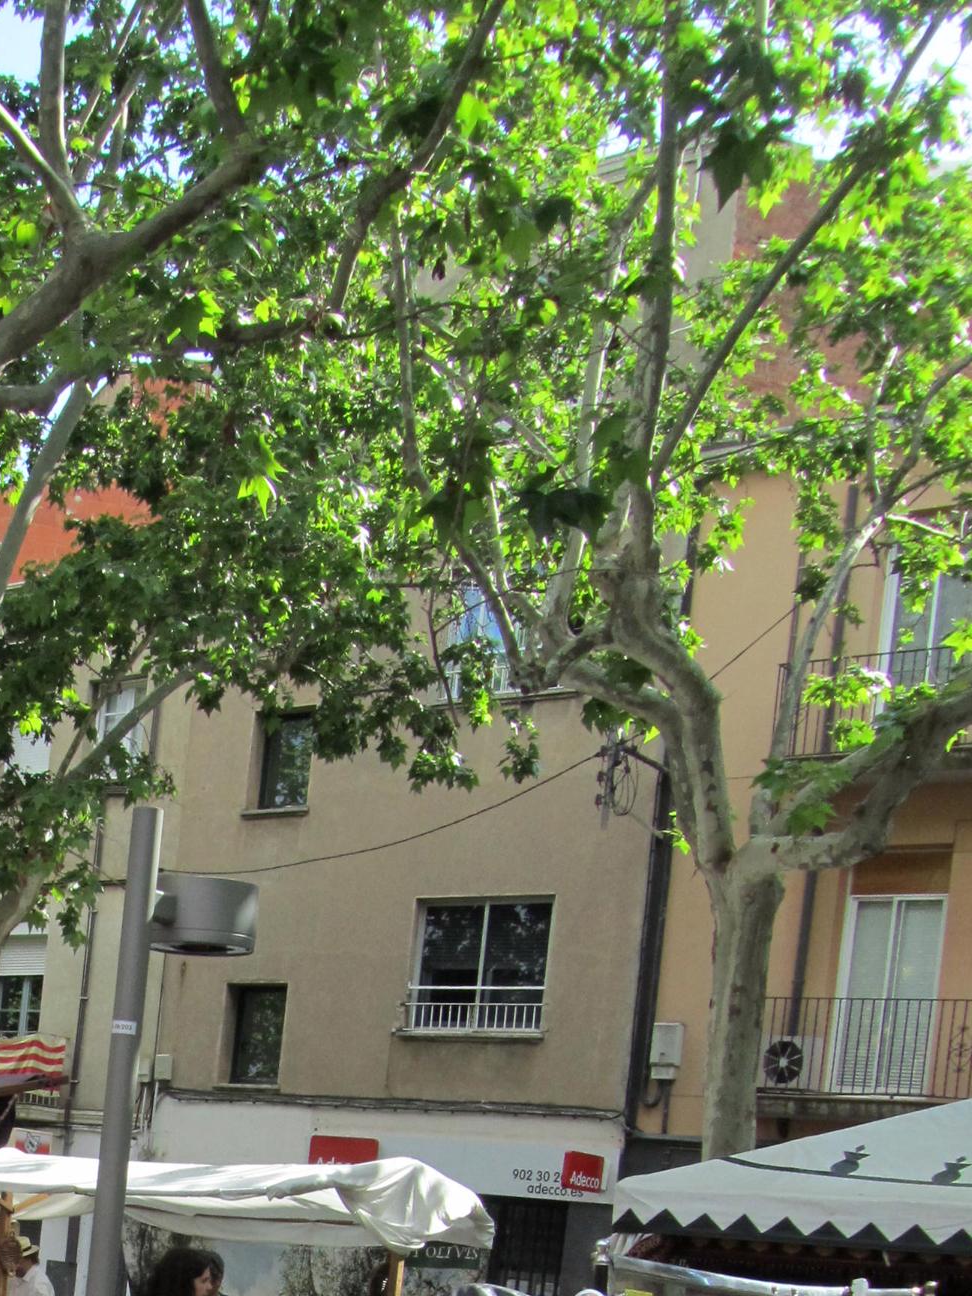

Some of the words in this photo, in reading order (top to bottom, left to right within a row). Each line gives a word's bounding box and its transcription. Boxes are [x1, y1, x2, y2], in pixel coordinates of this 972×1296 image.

[512, 1168, 533, 1181] 902
[536, 1170, 550, 1182] 30
[553, 1171, 562, 1183] 2
[569, 1170, 600, 1189] Adecco
[527, 1183, 584, 1198] adecco.es
